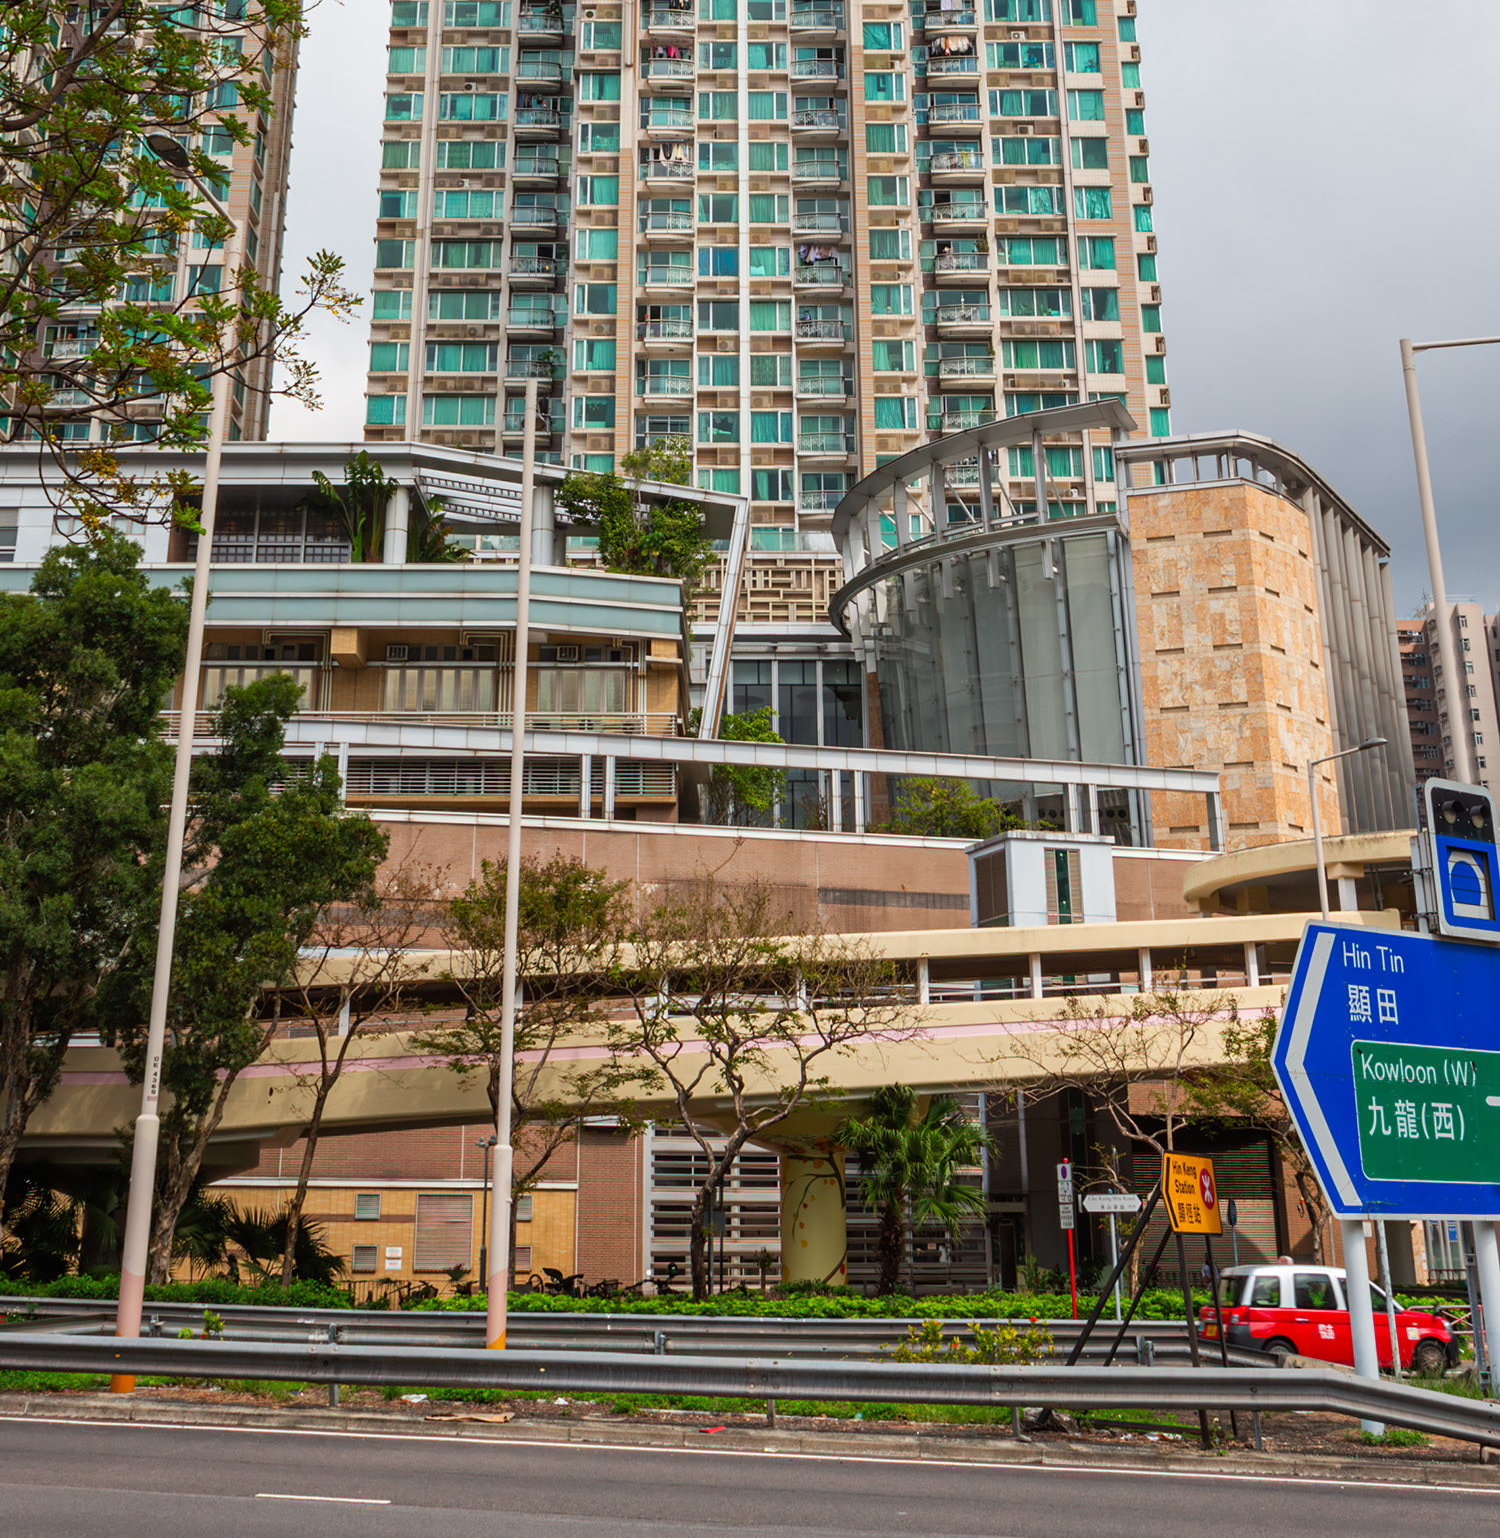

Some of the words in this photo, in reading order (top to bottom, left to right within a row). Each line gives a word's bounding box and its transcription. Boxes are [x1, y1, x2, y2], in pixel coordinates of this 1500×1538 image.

[1343, 941, 1371, 970] Hin
[1376, 945, 1404, 973] Tin
[1348, 984, 1399, 1025] 顯田
[1361, 1053, 1437, 1084] Kowloon
[1444, 1059, 1476, 1087] (W)
[1368, 1096, 1465, 1141] 九龍(西)
[1172, 1160, 1183, 1175] Hin
[1182, 1162, 1197, 1180] Keng
[1175, 1179, 1196, 1195] Station
